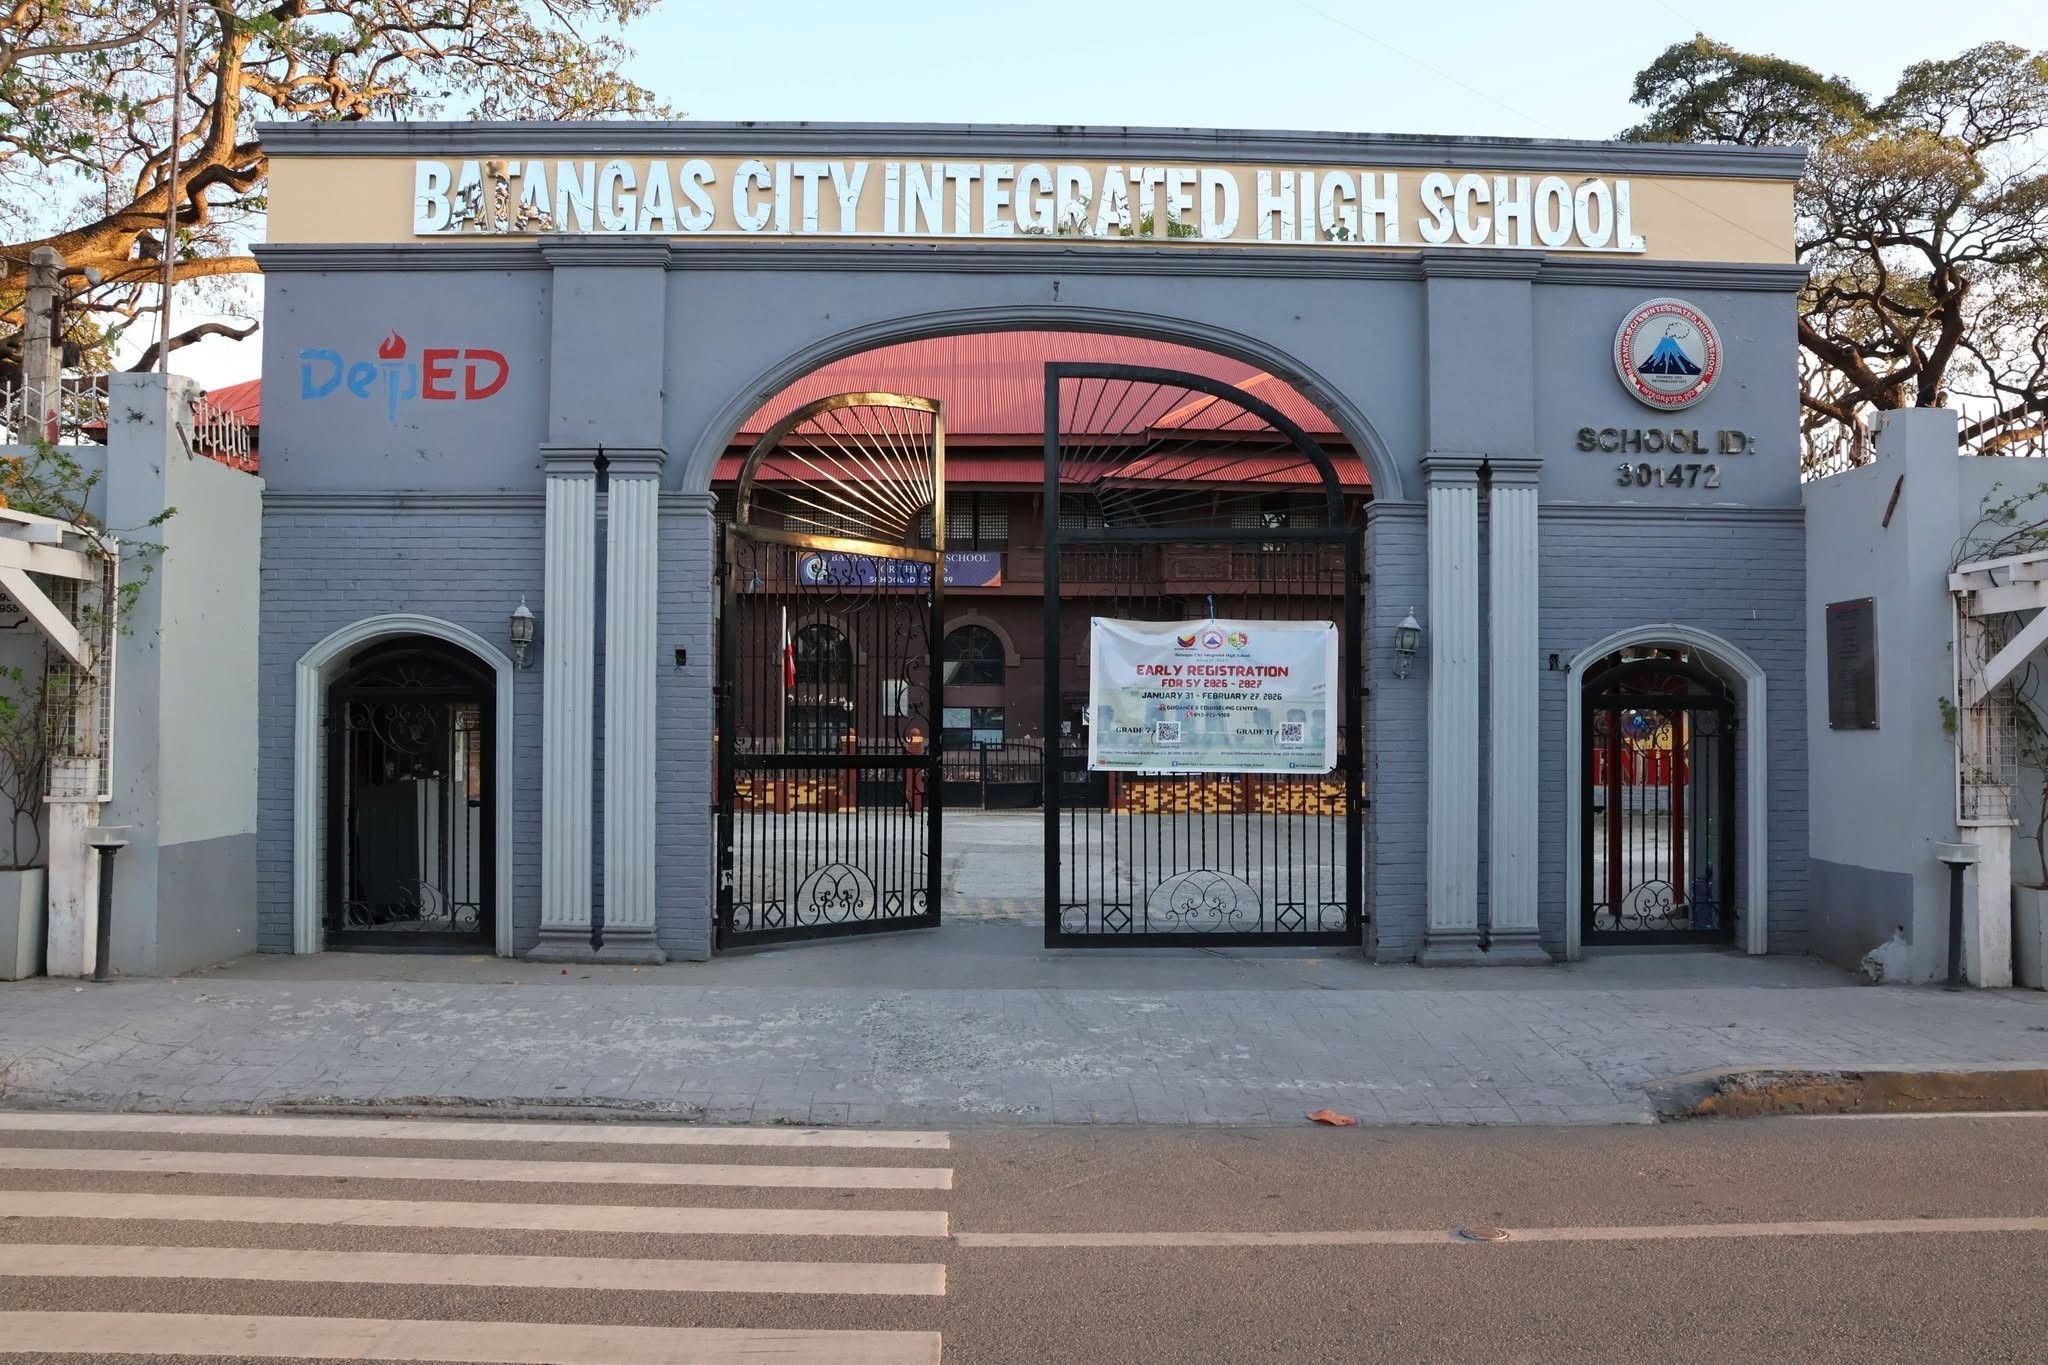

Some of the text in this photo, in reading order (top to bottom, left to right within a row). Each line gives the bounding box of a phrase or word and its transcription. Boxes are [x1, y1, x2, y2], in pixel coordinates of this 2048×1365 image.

[414, 158, 1647, 248] BATANGAS CITY INTEGRATED HIGH SCHOOL
[1577, 427, 1755, 455] SCHOOL ID:
[1616, 462, 1721, 488] 301472
[946, 554, 989, 562] SCHOOL
[1136, 664, 1289, 677] EARLY REGISTRATION
[1162, 678, 1183, 687] FOR
[1186, 678, 1199, 688] SY
[1204, 679, 1228, 688] 2026
[1238, 679, 1263, 688] 2027
[1141, 692, 1183, 700] JANUARY
[1202, 692, 1247, 700] FEBRUARY
